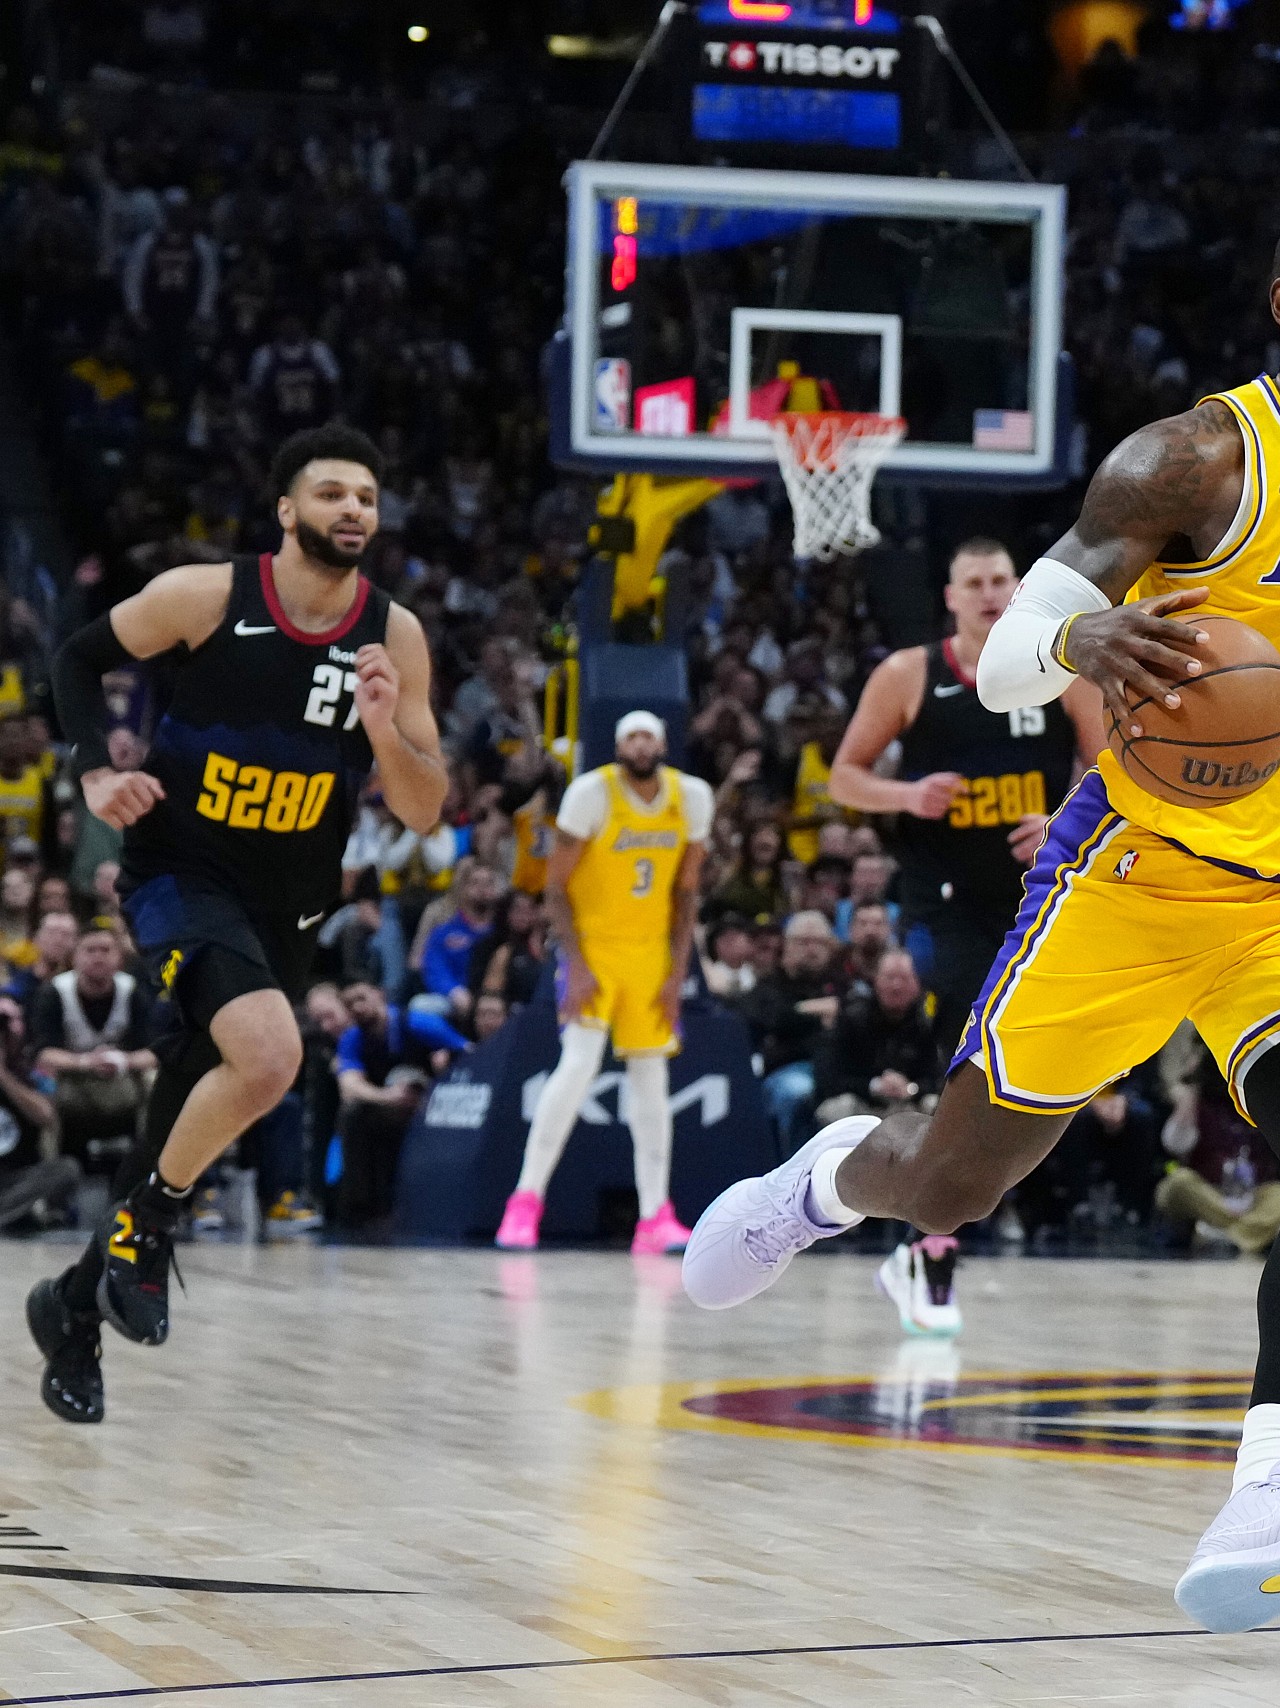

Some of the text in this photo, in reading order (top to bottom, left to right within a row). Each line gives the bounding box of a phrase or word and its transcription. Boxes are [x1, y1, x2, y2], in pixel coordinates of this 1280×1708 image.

[756, 42, 900, 80] TISSOT
[1009, 706, 1047, 738] 15
[195, 751, 336, 833] 5280
[949, 770, 1046, 829] 5280
[630, 857, 655, 899] 3
